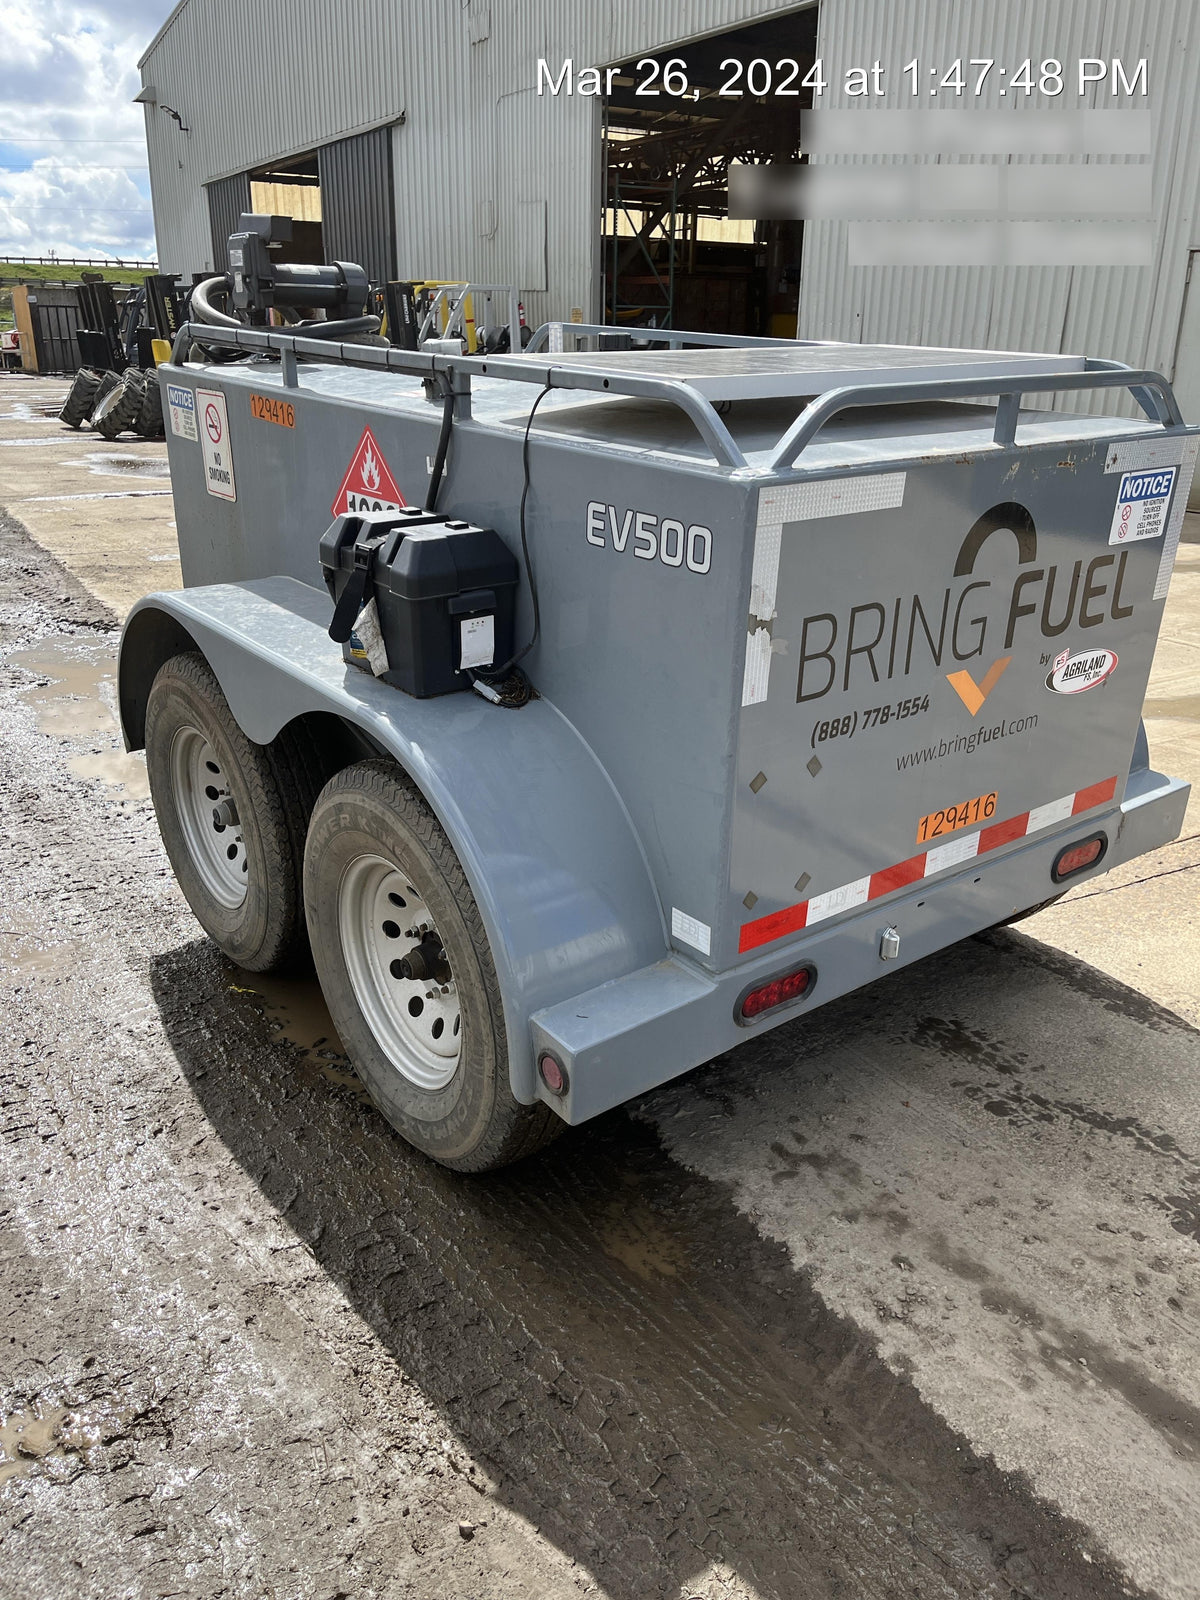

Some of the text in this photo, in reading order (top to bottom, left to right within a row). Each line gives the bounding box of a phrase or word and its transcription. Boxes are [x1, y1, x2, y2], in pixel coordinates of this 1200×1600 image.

[169, 389, 193, 408] NOTICE
[251, 395, 294, 428] 129416
[214, 452, 222, 466] NO
[209, 467, 231, 485] SMOKING
[1121, 474, 1171, 499] NOTICE
[1143, 506, 1161, 514] SOURCES
[586, 500, 713, 575] EV500
[796, 550, 1134, 704] BRING FUEL
[1039, 652, 1051, 667] by
[1062, 654, 1106, 679] AGRILAND
[810, 694, 930, 749] (888) 778-1554
[895, 712, 1039, 771] www.bringfuel.com
[919, 793, 997, 842] 129416
